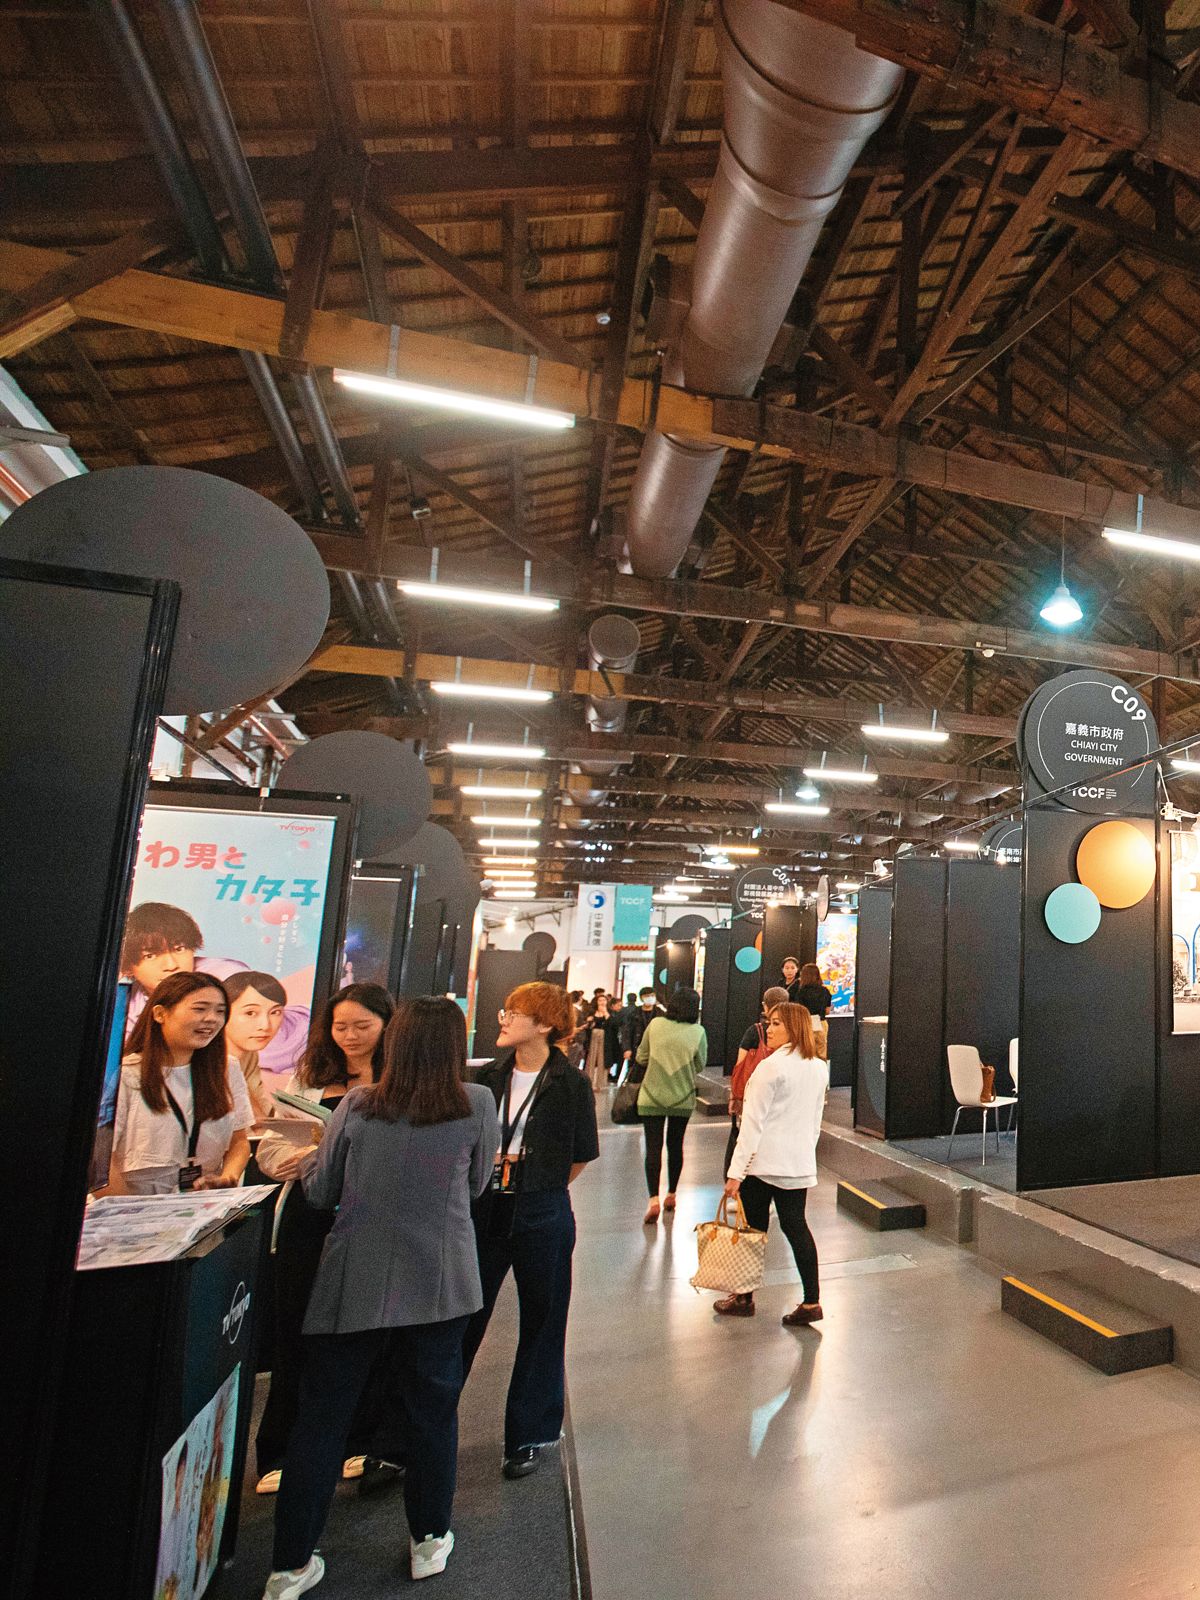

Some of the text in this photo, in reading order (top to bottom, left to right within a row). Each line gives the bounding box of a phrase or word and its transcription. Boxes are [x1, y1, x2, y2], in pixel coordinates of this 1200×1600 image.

[1111, 685, 1146, 721] C09
[1065, 722, 1124, 741] 嘉義市政府
[1071, 739, 1118, 752] CHIAYI CITY
[1064, 752, 1124, 766] GOVERNMENT
[1071, 786, 1105, 799] TCCF
[144, 841, 247, 870] わ男と
[215, 873, 320, 906] カタ子
